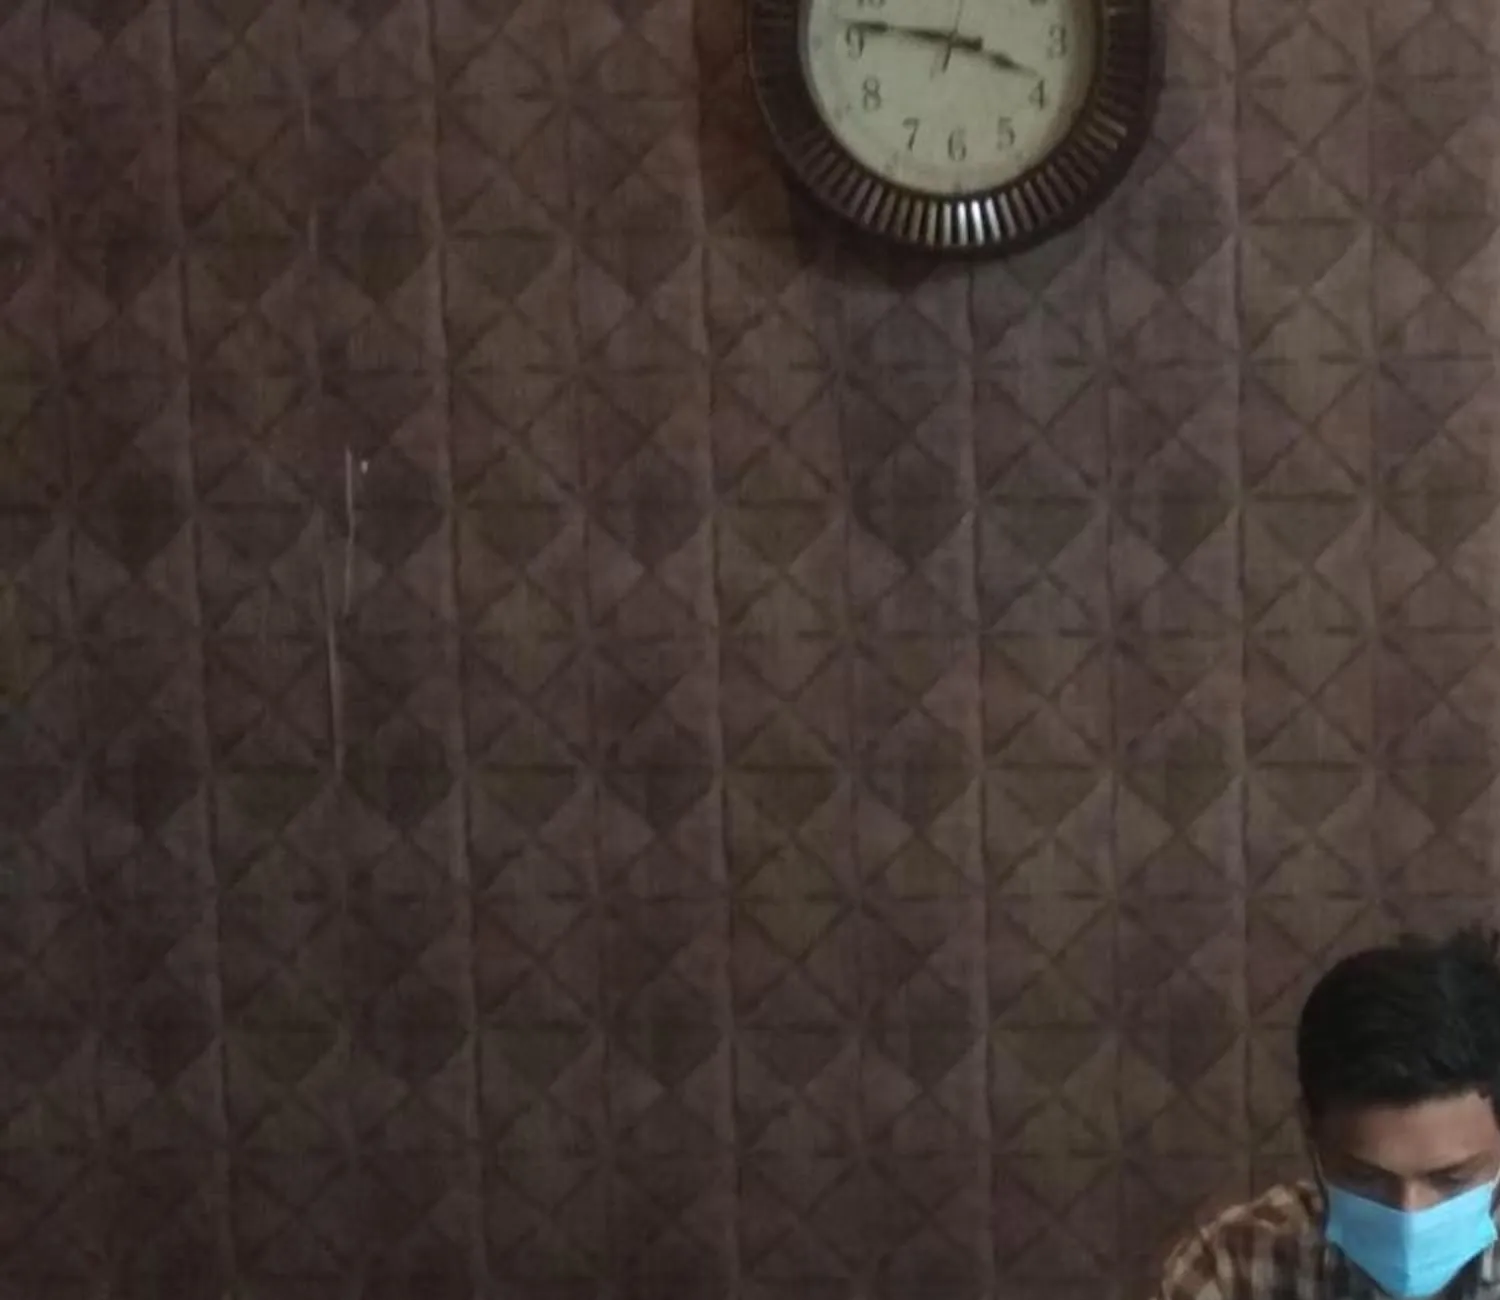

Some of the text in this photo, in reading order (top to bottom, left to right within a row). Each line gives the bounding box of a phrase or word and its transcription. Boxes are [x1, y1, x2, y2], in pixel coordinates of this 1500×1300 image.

[846, 23, 865, 60] 9
[1047, 26, 1067, 60] 3
[862, 78, 882, 111] 8
[1028, 79, 1046, 111] 4
[902, 118, 920, 152] 7
[947, 125, 967, 162] 6
[997, 117, 1016, 151] 5
